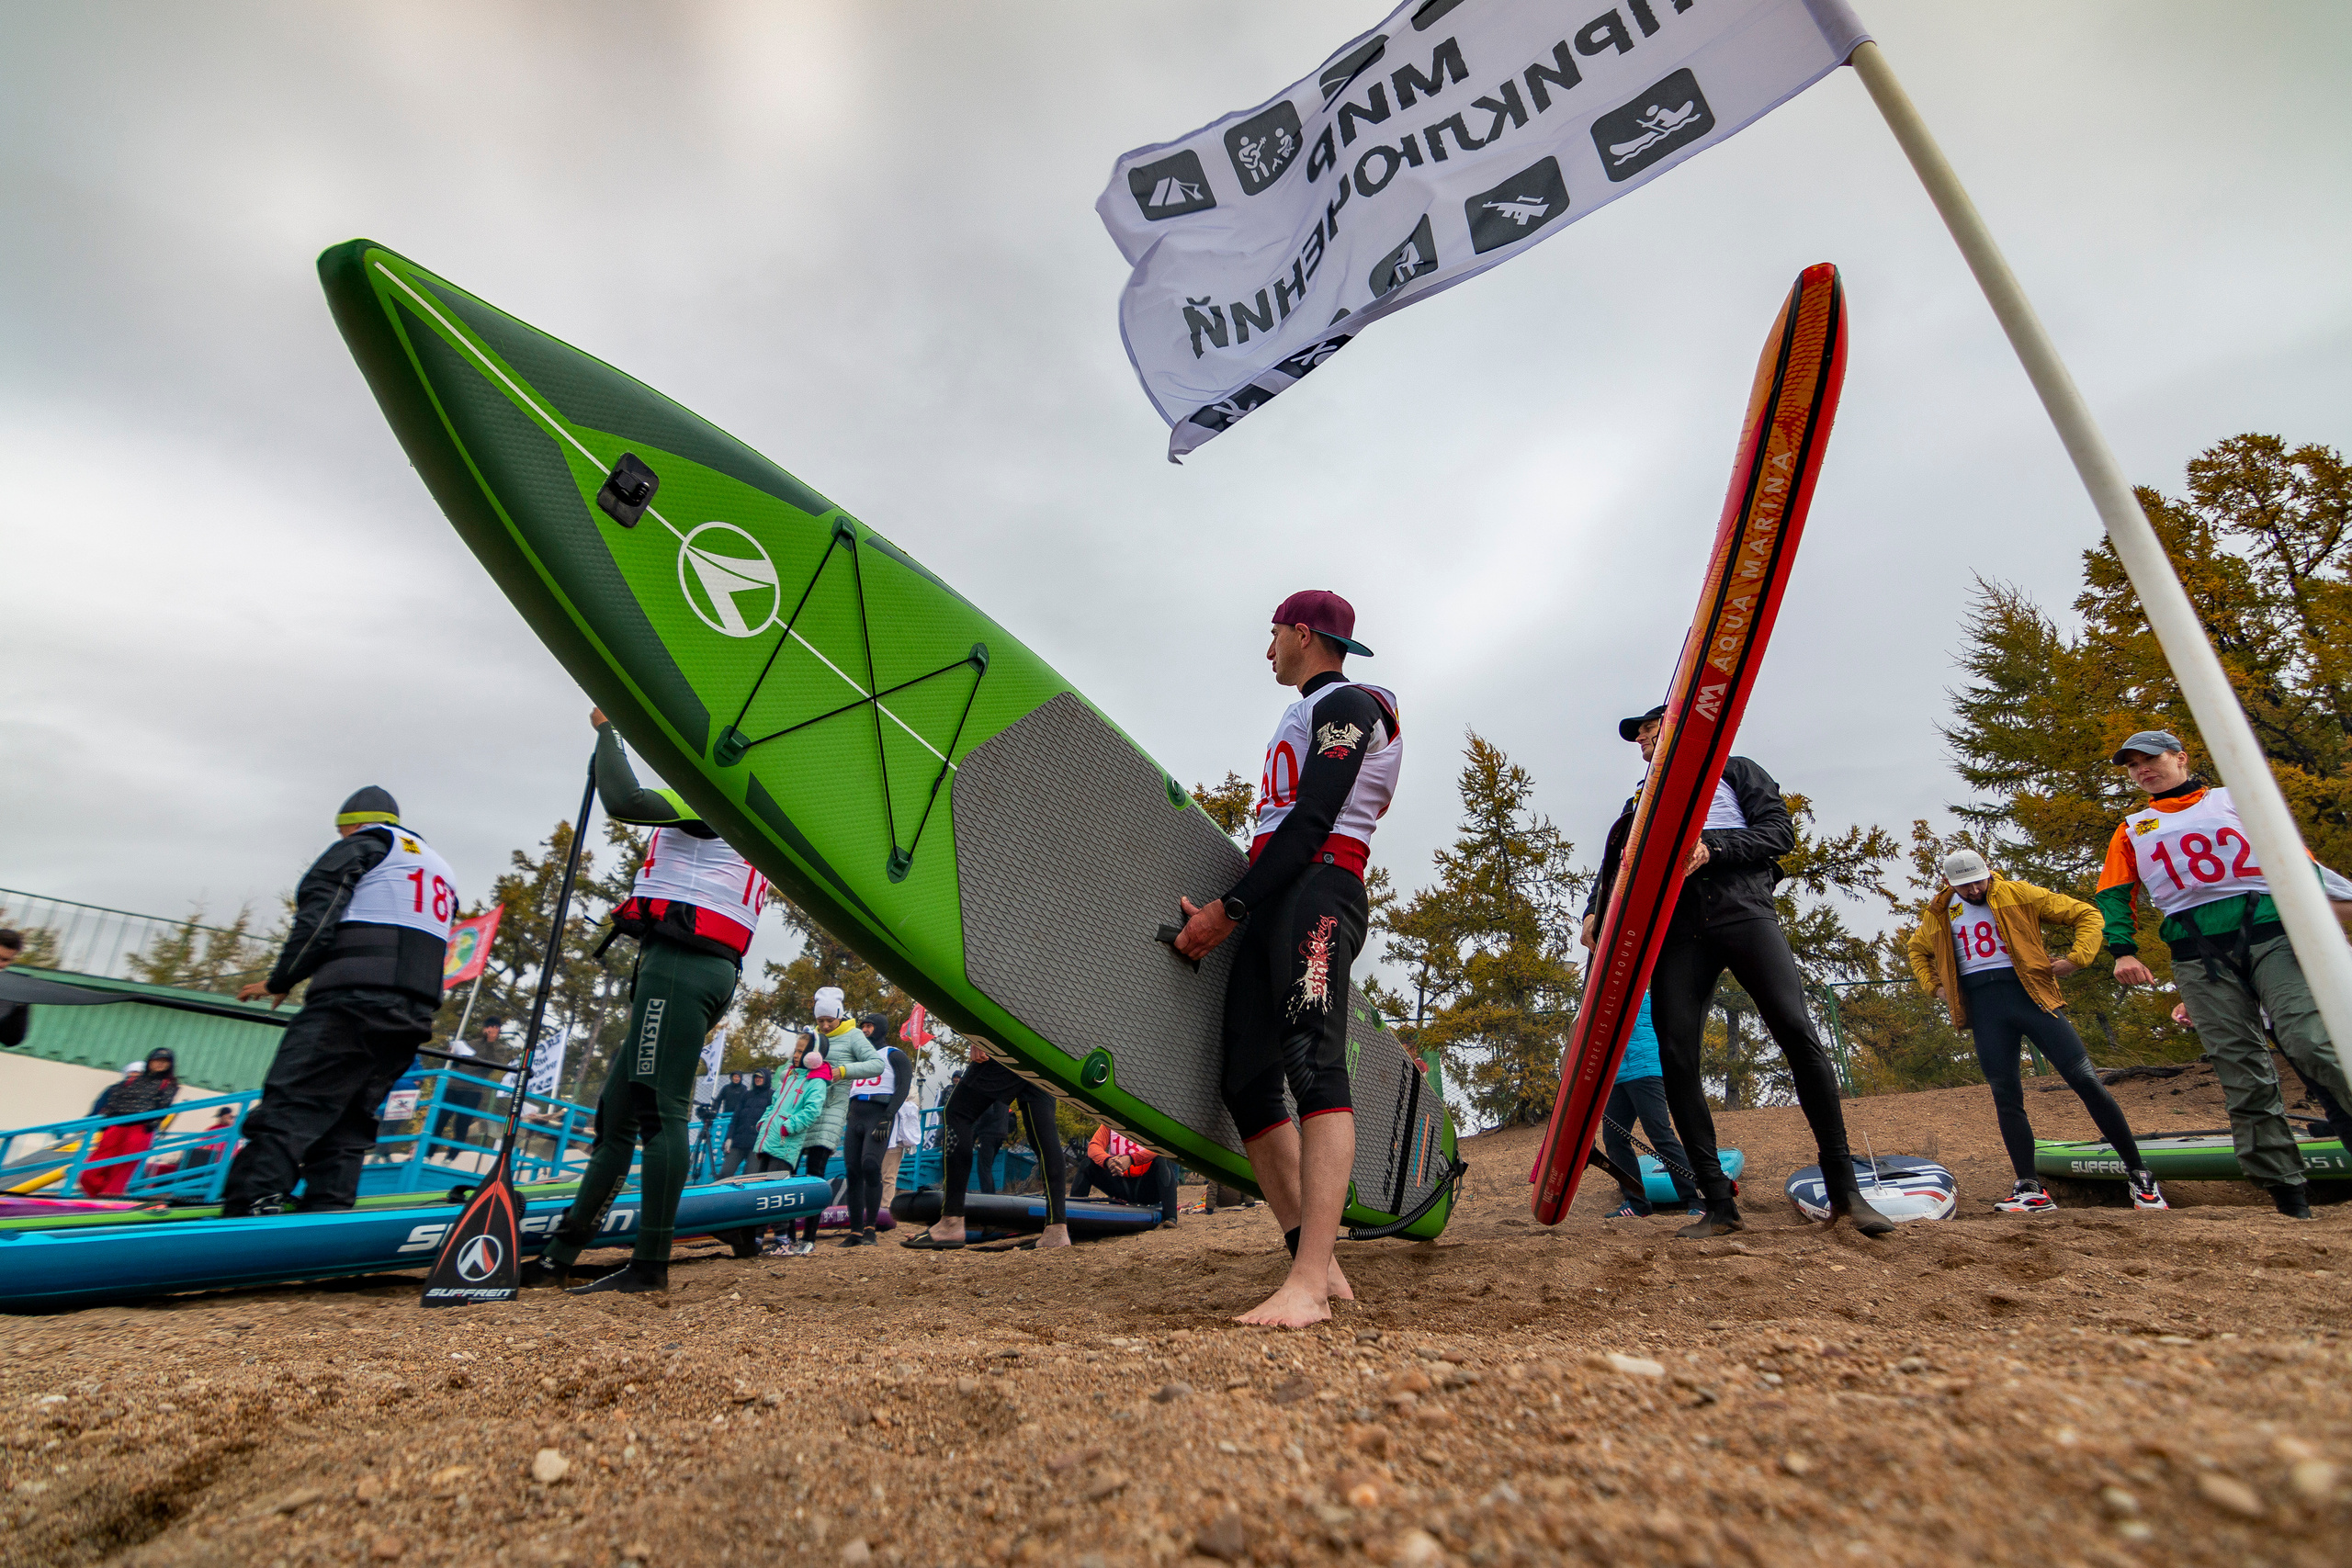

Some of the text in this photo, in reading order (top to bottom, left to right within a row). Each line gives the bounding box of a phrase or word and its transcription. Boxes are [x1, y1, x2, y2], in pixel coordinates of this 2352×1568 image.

[1713, 451, 1792, 671] AQUA MARINA
[2150, 827, 2264, 890] 182
[639, 999, 664, 1059] MYSTIC
[1583, 1041, 1602, 1081] WONDER
[1599, 1022, 1609, 1034] IS
[1384, 1059, 1409, 1201] SUPFREN
[2071, 1160, 2128, 1174] SUPFRE
[425, 1288, 511, 1298] SUPFREN
